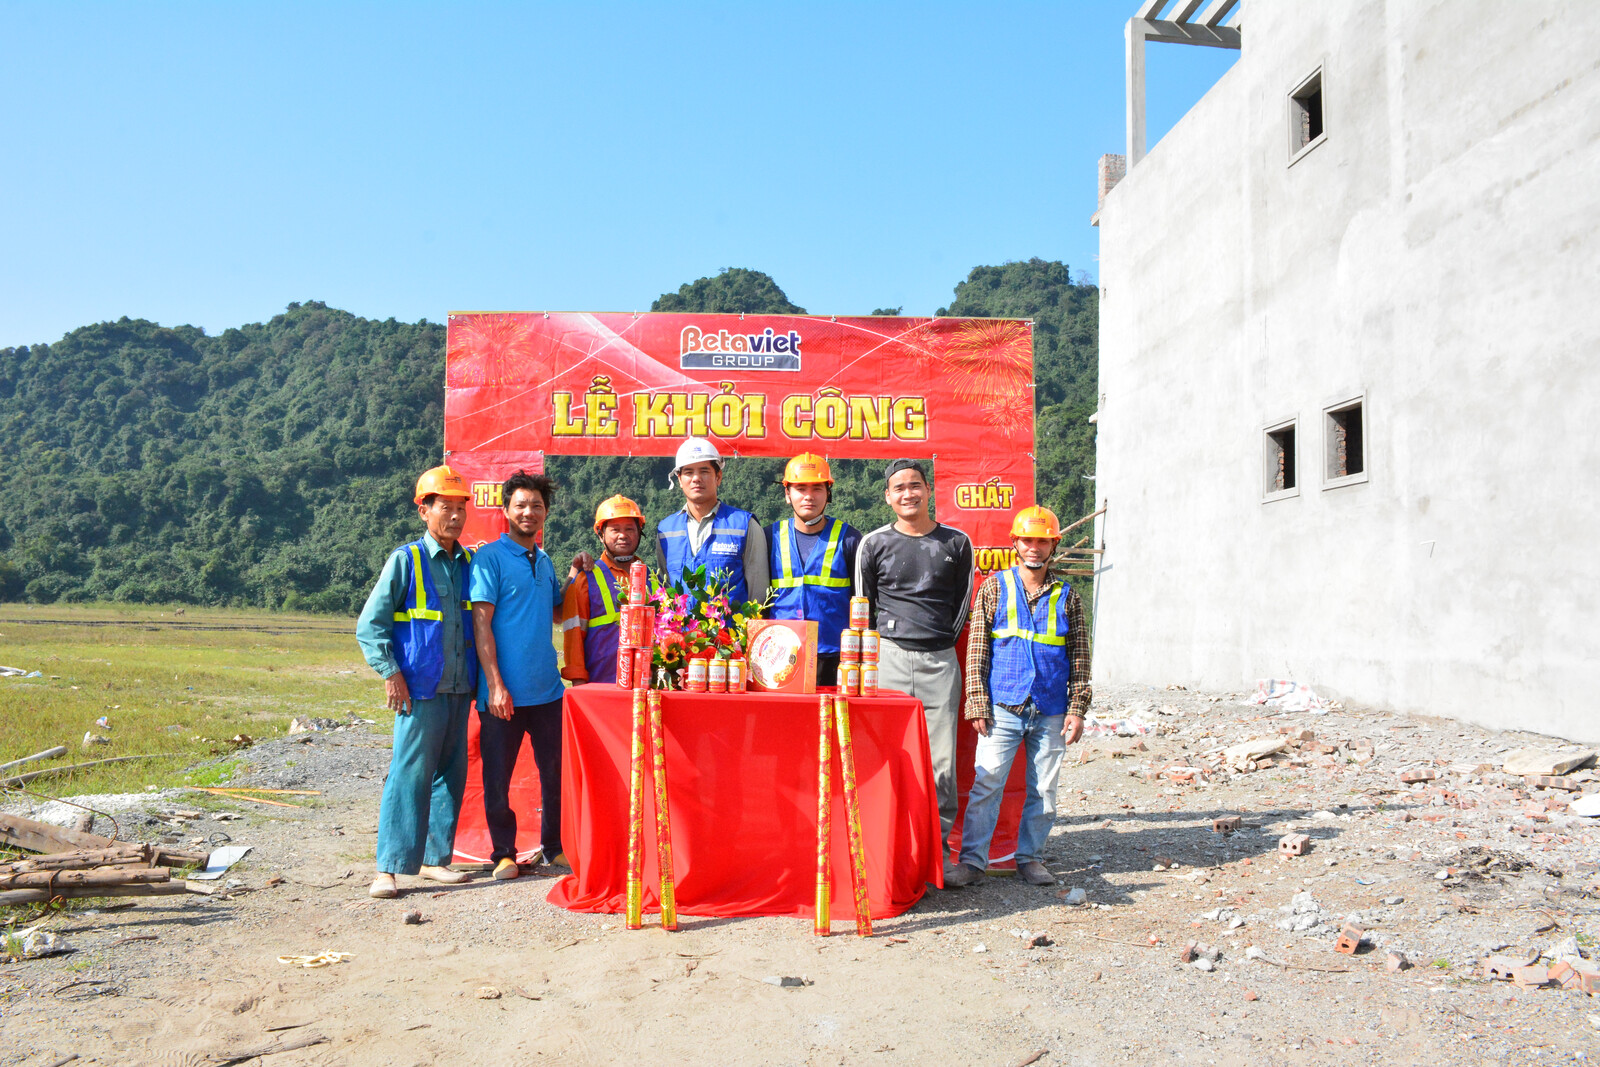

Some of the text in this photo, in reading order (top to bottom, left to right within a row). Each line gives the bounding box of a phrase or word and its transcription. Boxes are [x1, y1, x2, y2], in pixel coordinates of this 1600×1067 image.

[682, 326, 801, 357] Betaviet
[712, 356, 775, 367] GROUP
[552, 375, 928, 441] LỄ KHỞI CÔNG
[473, 482, 505, 508] TH
[955, 477, 1015, 510] CHẤT
[974, 547, 1021, 576] ỢNG
